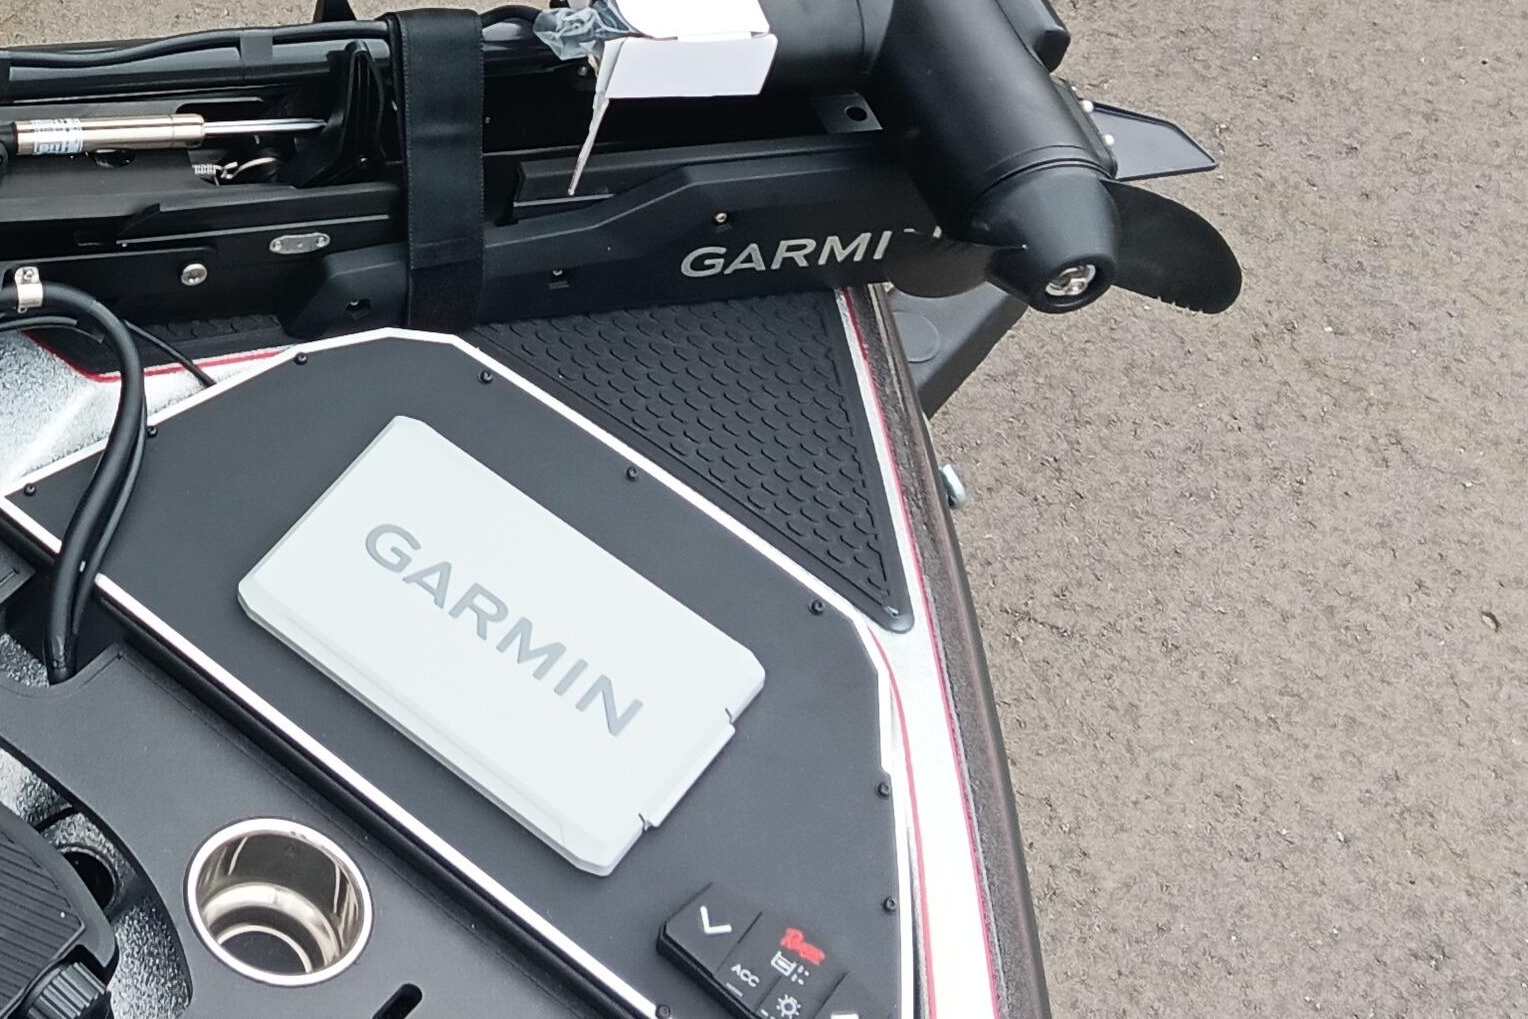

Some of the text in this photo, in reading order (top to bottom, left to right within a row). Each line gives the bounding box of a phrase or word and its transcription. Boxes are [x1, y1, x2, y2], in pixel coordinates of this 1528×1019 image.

[680, 225, 943, 279] GARMI
[365, 523, 644, 737] GARMIN
[730, 963, 760, 989] ACC
